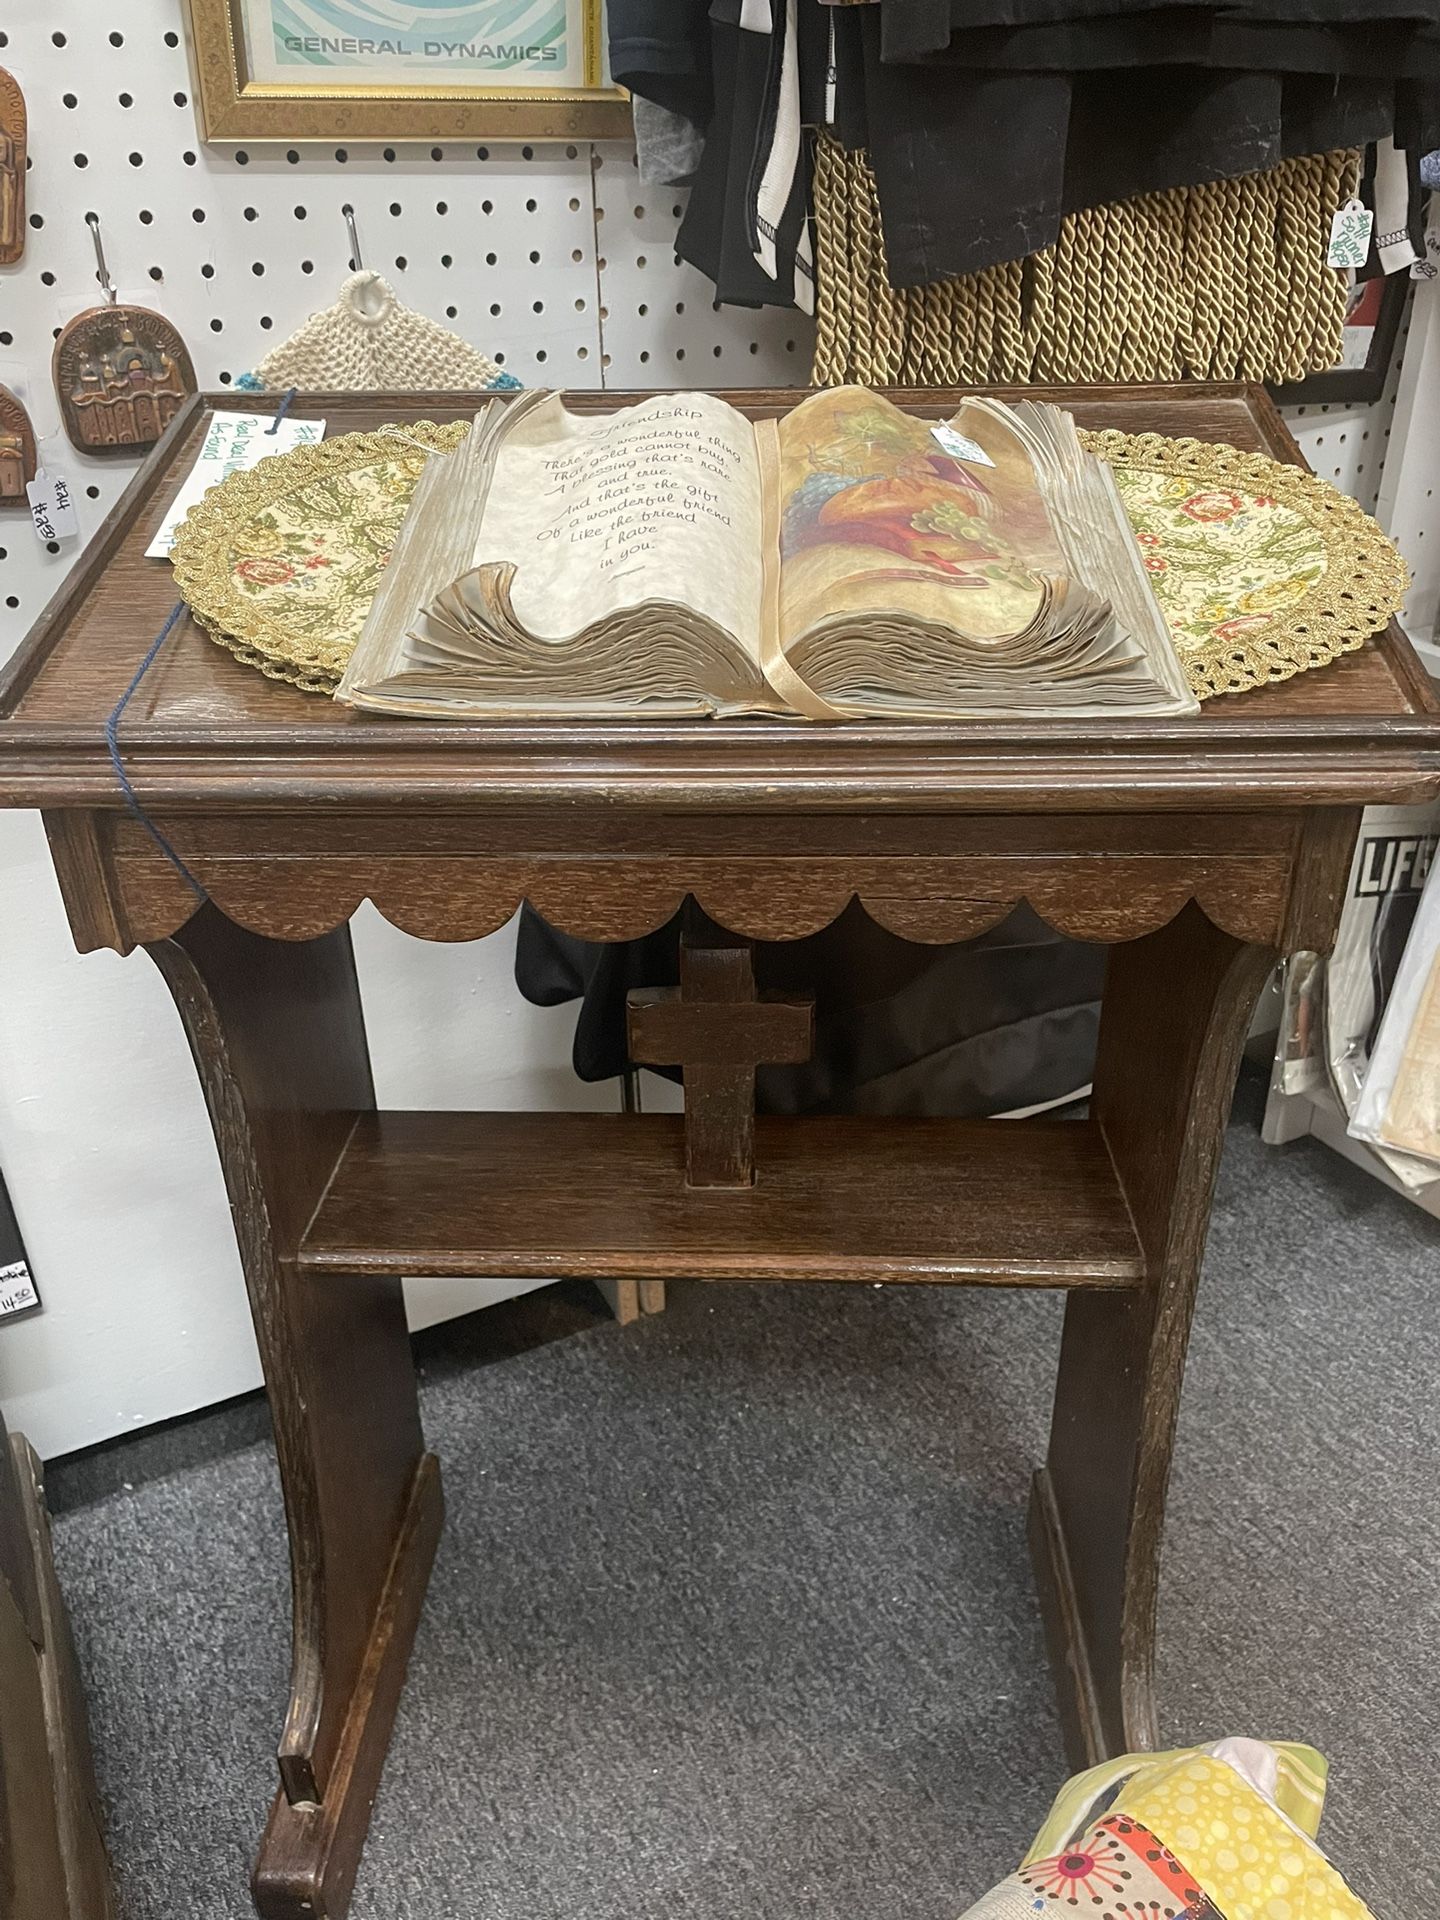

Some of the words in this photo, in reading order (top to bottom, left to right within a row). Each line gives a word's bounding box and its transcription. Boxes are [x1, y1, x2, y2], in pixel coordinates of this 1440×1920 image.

[283, 36, 412, 55] GENERAL
[424, 41, 558, 61] DYNAMICS
[235, 418, 259, 439] Real
[226, 439, 250, 459] Deal
[540, 448, 594, 470] There's
[600, 444, 612, 452] a
[617, 429, 702, 446] wonderful
[708, 436, 741, 464] thing
[550, 465, 584, 482] That
[590, 447, 628, 468] gold
[635, 442, 691, 454] cannot
[698, 444, 729, 468] buy.
[544, 484, 565, 496] A
[572, 460, 637, 489] blessing
[645, 453, 694, 464] that's
[700, 460, 733, 483] rare
[598, 471, 628, 488] and
[636, 467, 673, 478] true.
[536, 527, 563, 541] Of
[569, 518, 580, 528] a
[587, 493, 676, 521] wonderful
[683, 498, 733, 529] friend
[552, 497, 591, 523] And
[598, 482, 646, 502] that's
[654, 479, 680, 490] the
[686, 485, 719, 503] gift
[571, 528, 604, 543] Like
[611, 515, 635, 531] the
[642, 509, 697, 525] friend
[603, 537, 614, 552] I
[618, 525, 658, 545] have
[600, 559, 614, 569] in
[620, 541, 656, 562] you.
[1360, 840, 1437, 893] LIFE
